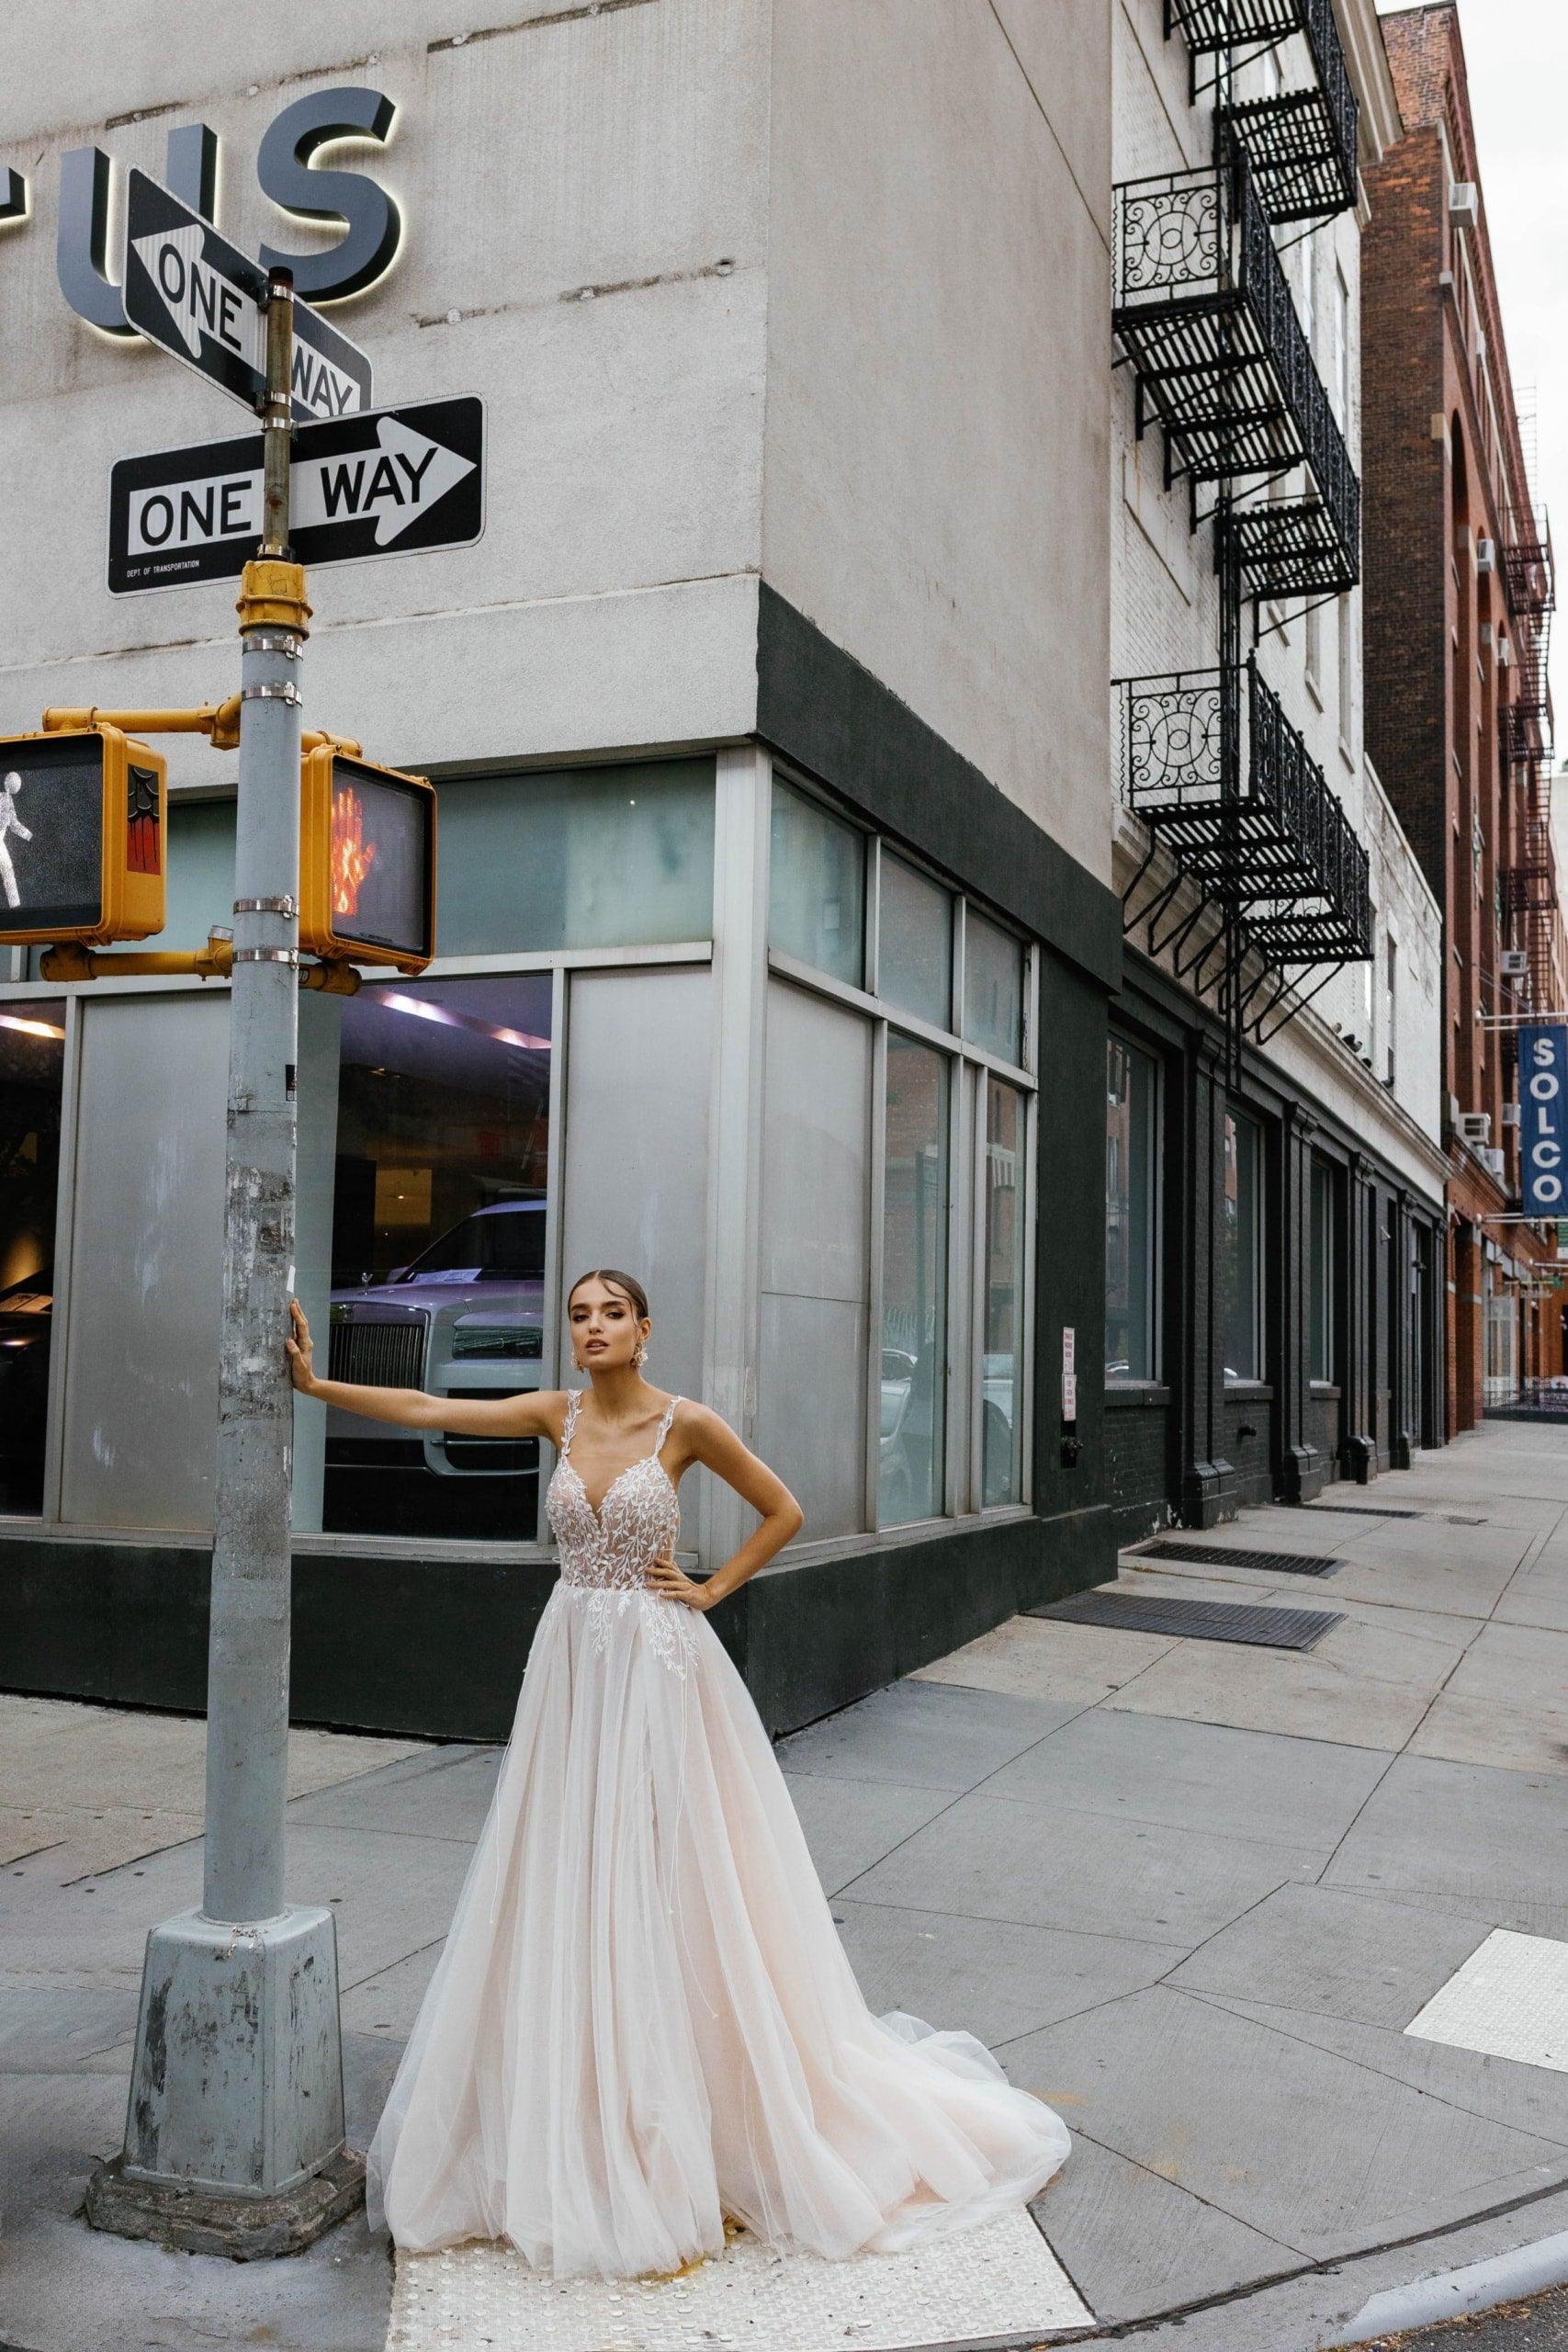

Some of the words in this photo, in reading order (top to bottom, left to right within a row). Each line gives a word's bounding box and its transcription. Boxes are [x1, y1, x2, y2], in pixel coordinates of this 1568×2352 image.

[0, 87, 397, 336] US
[159, 243, 243, 352] ONE
[291, 345, 354, 417] WAY
[140, 480, 252, 547] ONE
[320, 447, 439, 518] WAY
[143, 567, 152, 575] OF
[153, 560, 200, 573] TRANSPORTATION
[1529, 1037, 1562, 1203] SOLCO
